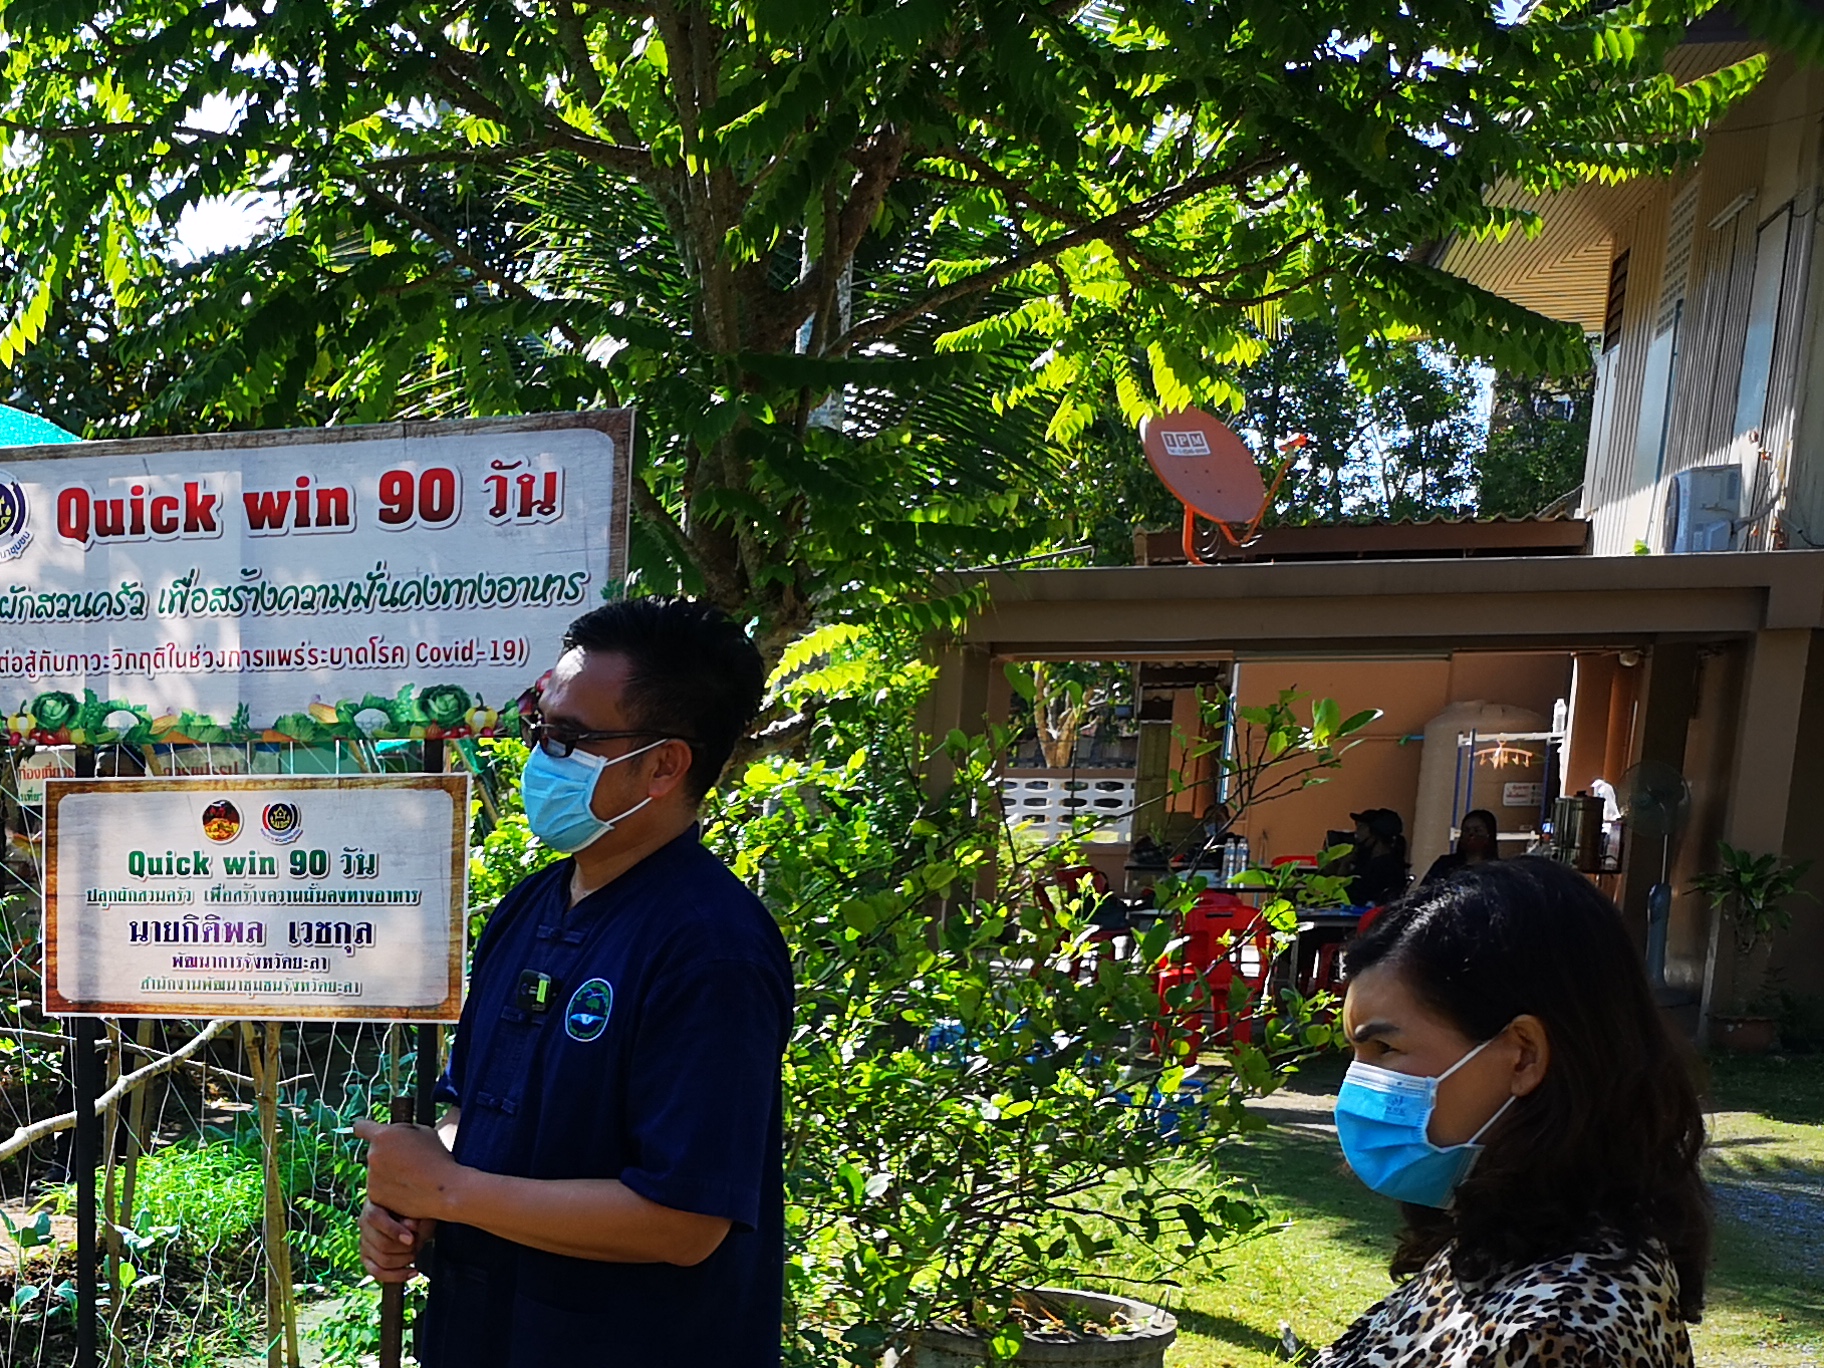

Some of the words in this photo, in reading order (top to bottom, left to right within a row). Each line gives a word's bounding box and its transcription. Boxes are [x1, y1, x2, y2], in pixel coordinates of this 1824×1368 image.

[1164, 433, 1205, 447] IPM
[57, 480, 217, 544] Quick
[243, 476, 350, 531] win
[378, 467, 455, 525] 90
[484, 459, 557, 519] วัน
[159, 561, 587, 615] เพื่อสร้างความมั่นคงทางอาหาร
[415, 637, 526, 665] Covid-19)
[128, 850, 210, 877] Quick
[223, 850, 276, 876] win
[289, 849, 327, 876] 90
[340, 846, 376, 875] วัน
[86, 887, 193, 906] ปลูกผักสวนครัว
[205, 882, 421, 904] เพื่อสร้างความมั่นคงทางอาหาร
[129, 913, 264, 943] นายกิติพล
[288, 920, 373, 954] เวชกุล
[172, 952, 328, 970] พัฒนาการจังหวัดยะลา
[140, 975, 360, 996] สำนักงานพัฒนาชุมชนจังหวัดยะลา
